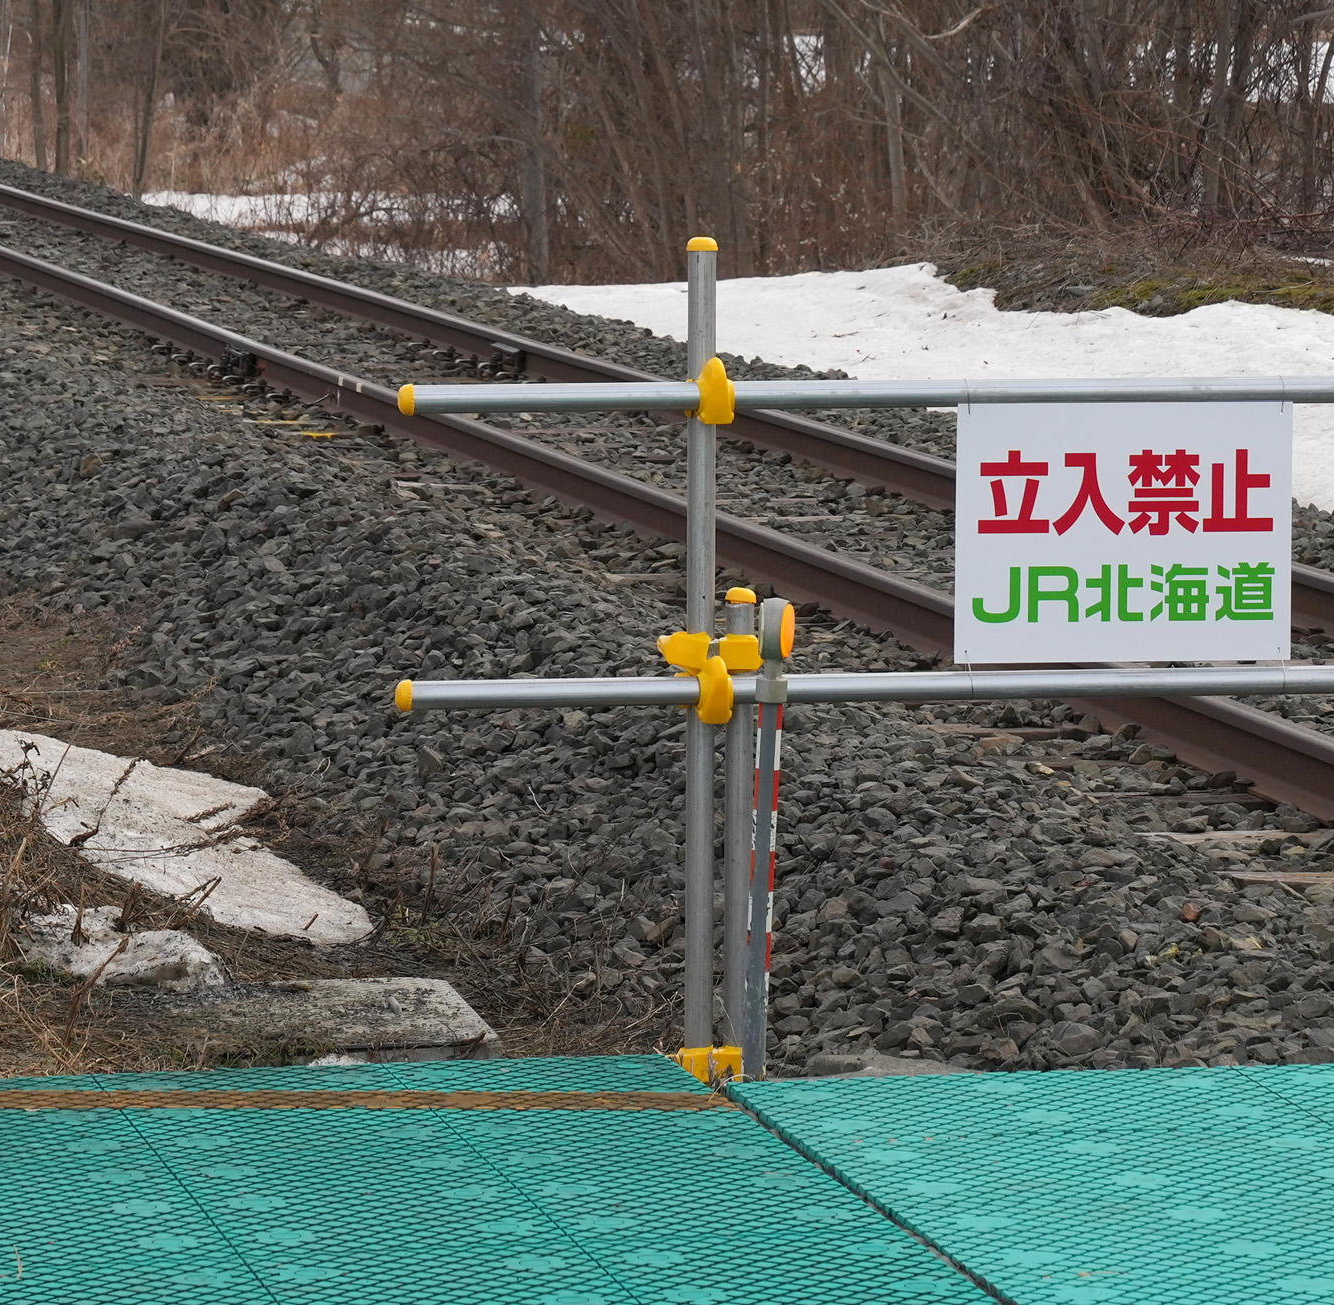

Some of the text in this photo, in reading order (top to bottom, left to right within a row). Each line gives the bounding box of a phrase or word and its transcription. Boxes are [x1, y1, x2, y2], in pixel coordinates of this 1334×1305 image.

[977, 448, 1274, 536] 立入禁止
[971, 561, 1276, 624] JR北海道
